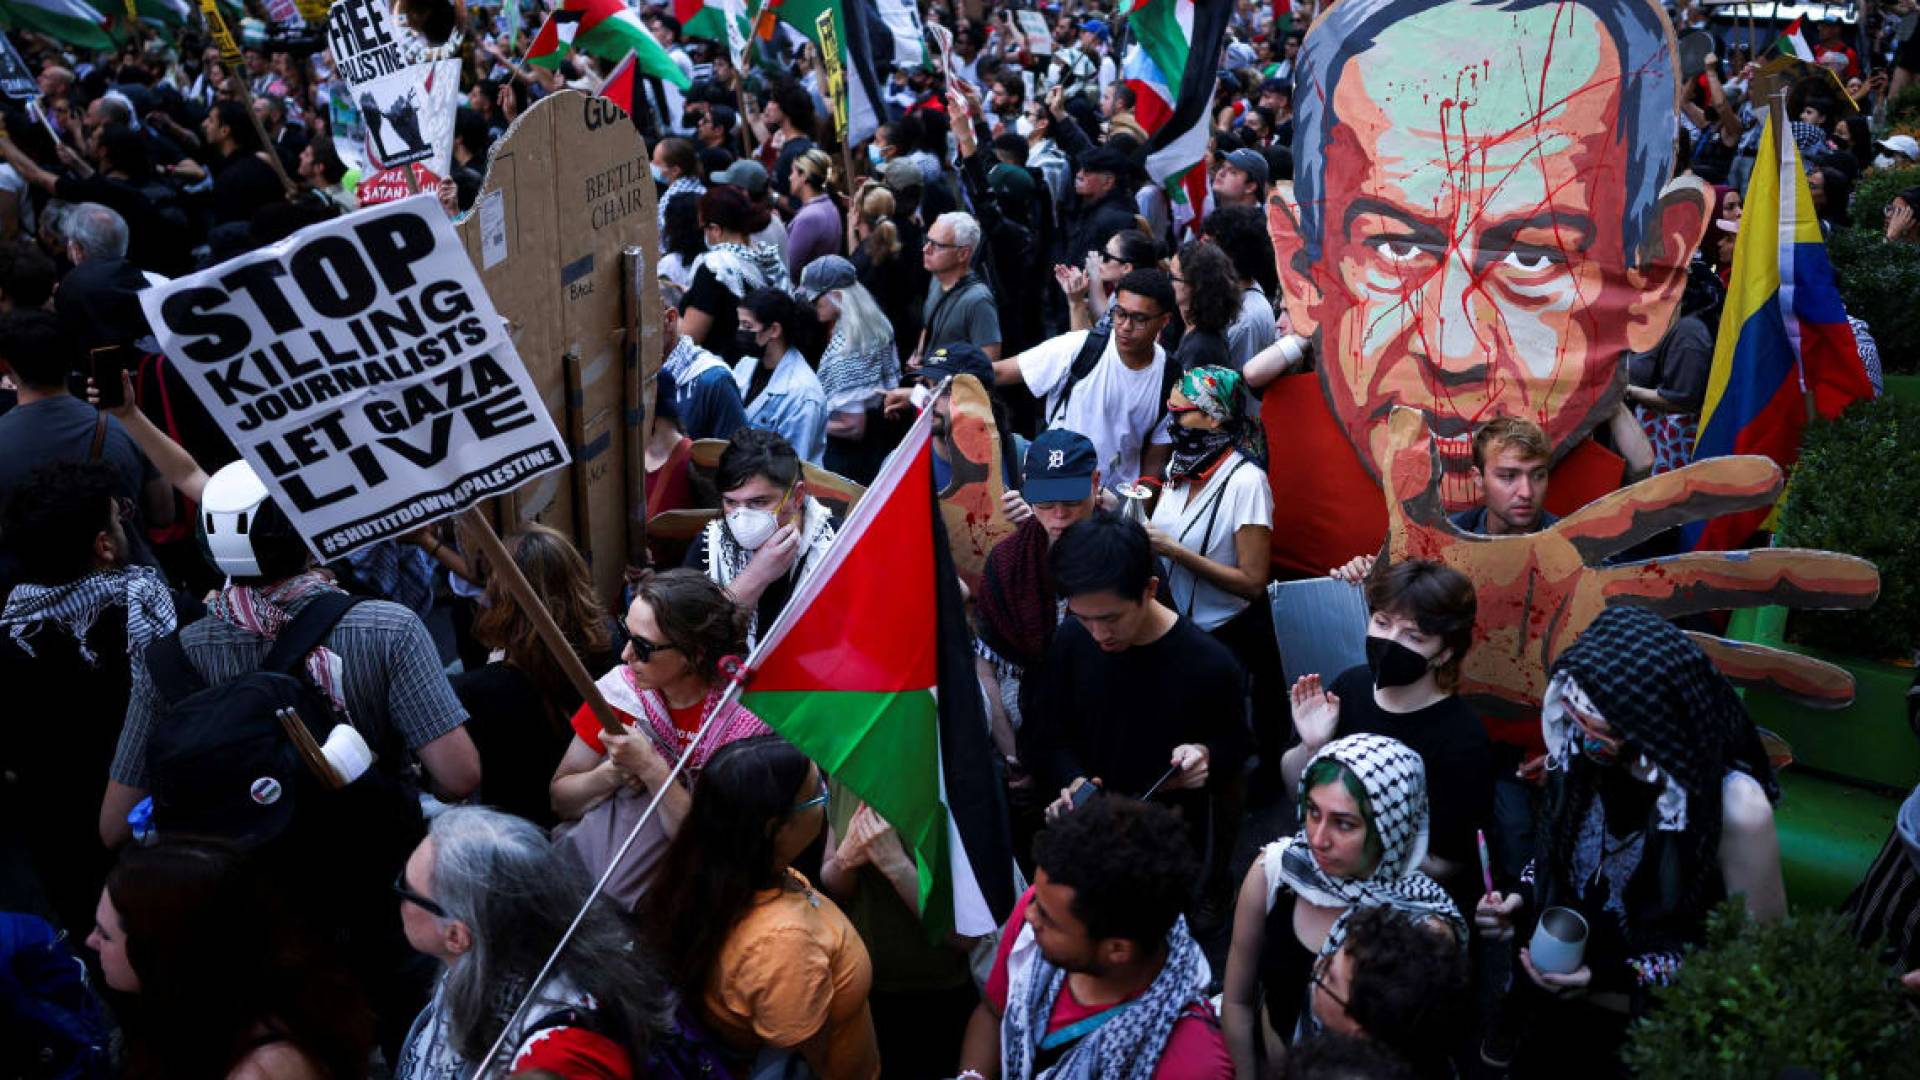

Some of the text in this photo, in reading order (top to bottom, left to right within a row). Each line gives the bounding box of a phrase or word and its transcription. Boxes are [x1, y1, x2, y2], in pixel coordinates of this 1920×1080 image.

[331, 0, 392, 60] FREE
[585, 155, 646, 203] BEETLE
[591, 188, 642, 231] CHAIR
[161, 213, 435, 363] STOP
[204, 280, 474, 407] KILLING
[236, 317, 487, 431] JOURNALISTS
[254, 352, 514, 478] LET GAZA
[279, 386, 537, 513] LIVE
[322, 447, 554, 553] #SHUTITDOWN4PALESTINE
